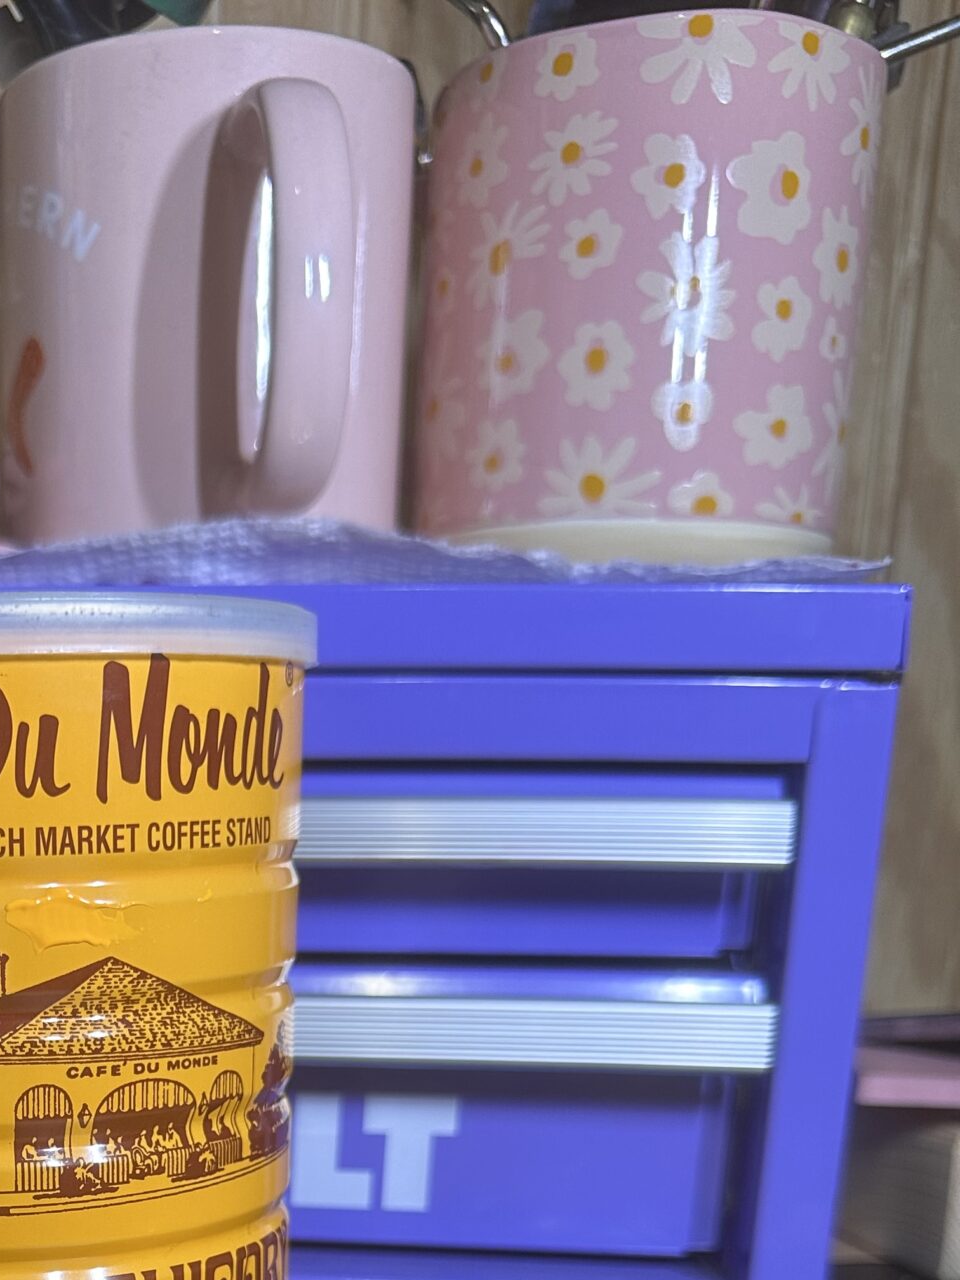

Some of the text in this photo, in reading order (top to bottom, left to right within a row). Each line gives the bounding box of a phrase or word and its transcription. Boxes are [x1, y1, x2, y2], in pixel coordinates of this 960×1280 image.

[35, 823, 140, 857] MARKET
[147, 819, 221, 852] COFFEE
[226, 815, 271, 848] STAND
[133, 1062, 160, 1075] DU
[167, 1055, 218, 1072] MONDE
